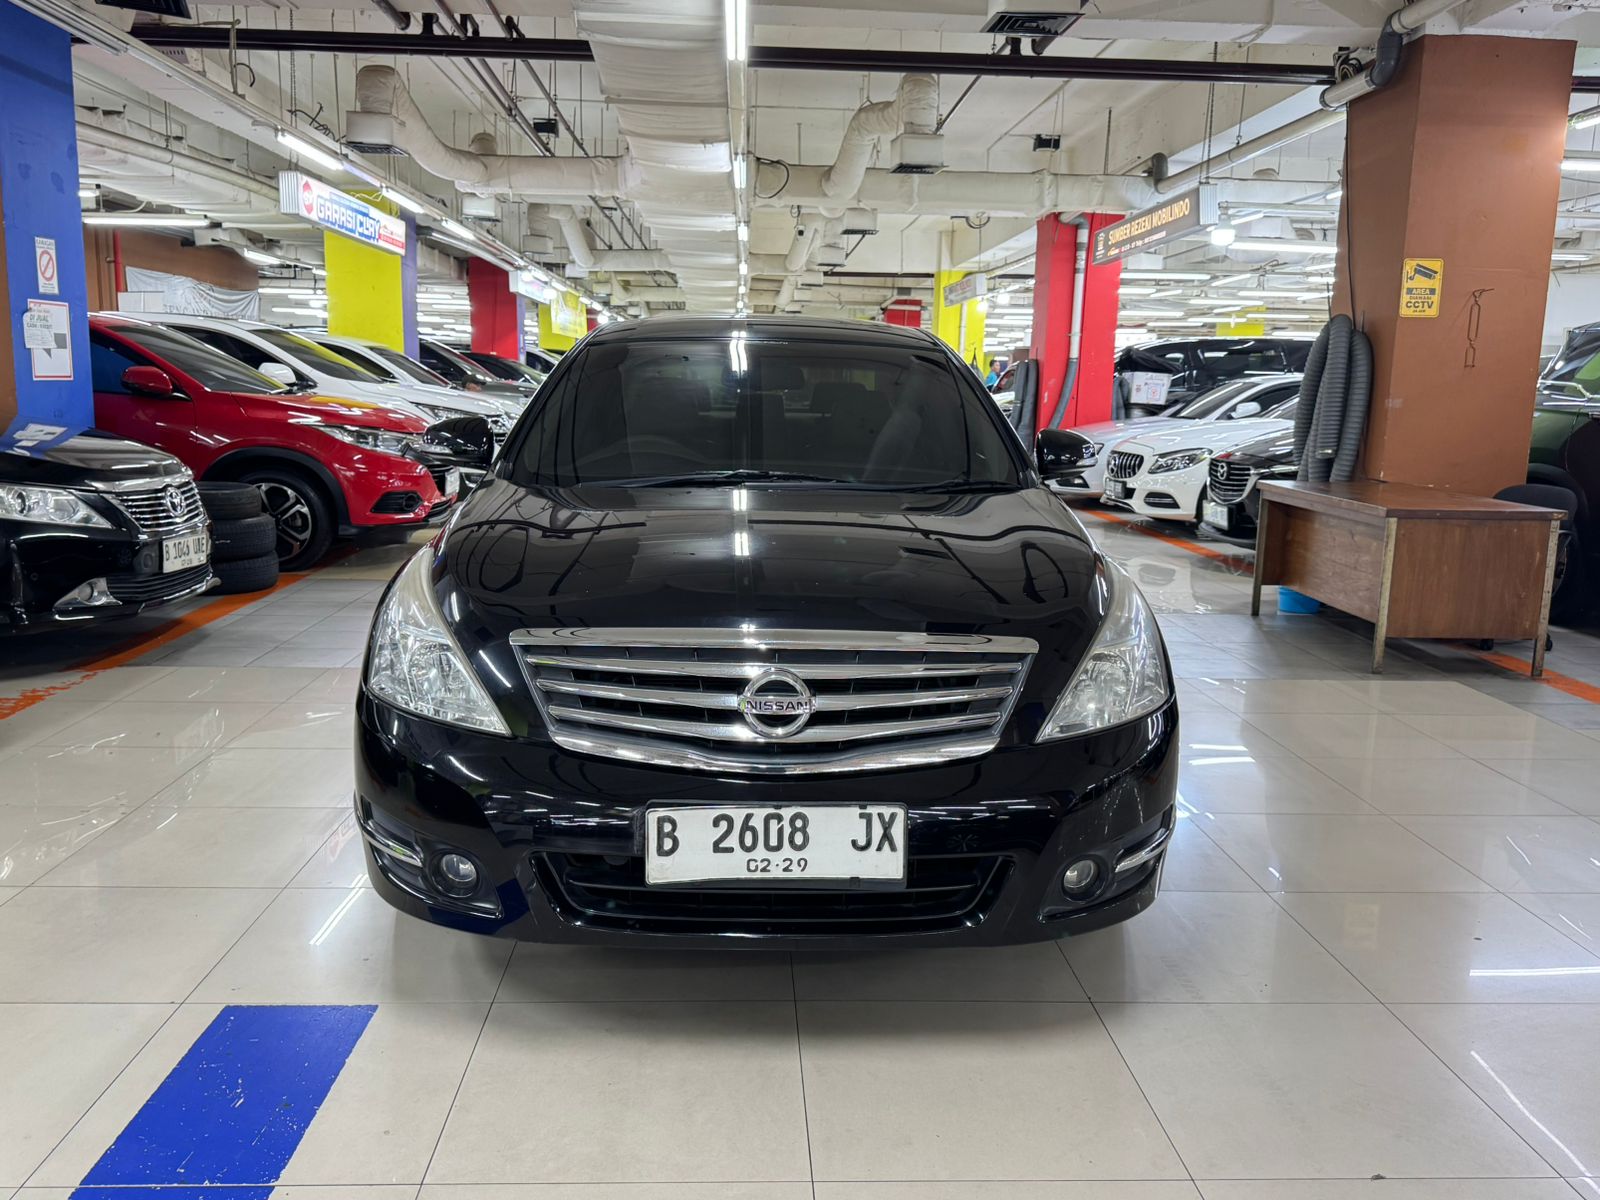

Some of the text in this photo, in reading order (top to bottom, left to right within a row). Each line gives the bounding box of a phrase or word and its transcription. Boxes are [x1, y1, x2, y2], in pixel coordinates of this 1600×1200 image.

[318, 197, 356, 232] GARASI
[1108, 223, 1131, 245] SUMBER
[1152, 198, 1190, 226] MOBILINDO
[1405, 300, 1434, 309] CCTV
[165, 544, 170, 562] B
[746, 700, 808, 711] NISSAN
[656, 811, 898, 857] B 2608 JX
